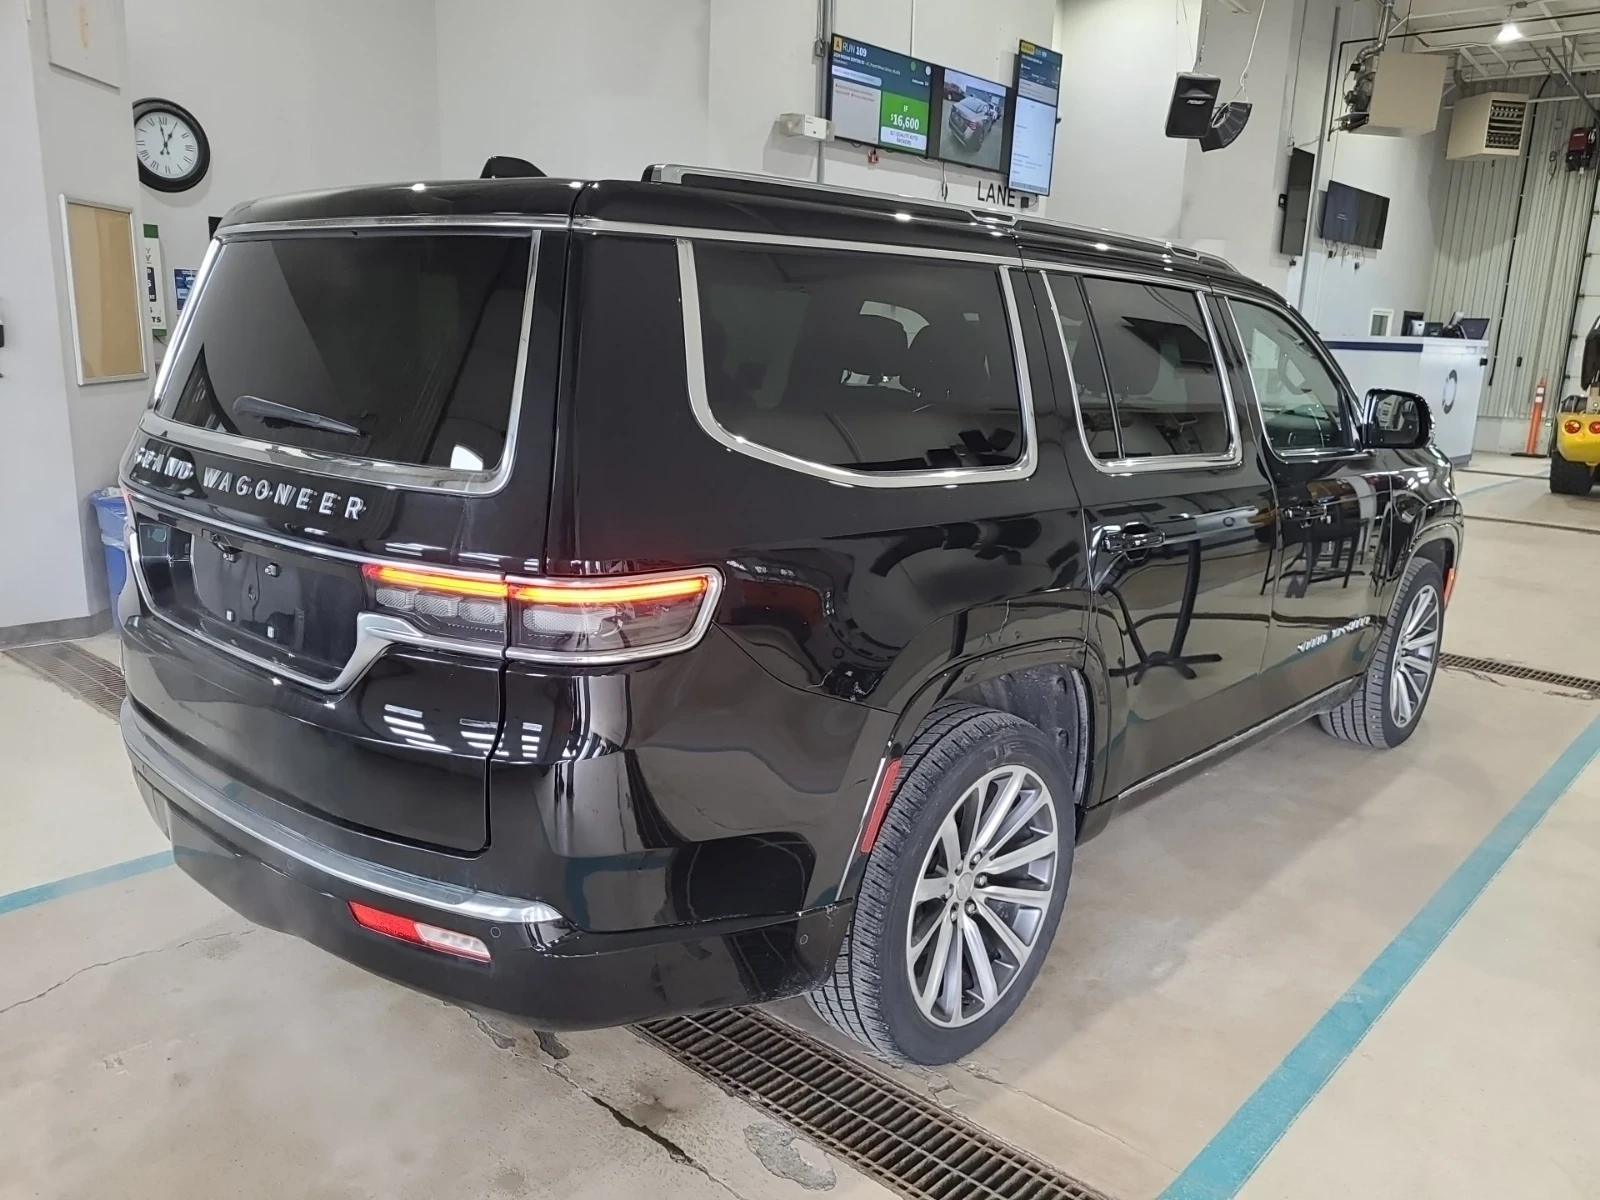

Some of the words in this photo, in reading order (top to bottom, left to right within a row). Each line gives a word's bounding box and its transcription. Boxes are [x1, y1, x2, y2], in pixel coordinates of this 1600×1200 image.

[842, 42, 856, 53] RUN
[855, 46, 867, 57] 109
[890, 112, 920, 131] $16,600
[977, 180, 1016, 208] LANE
[203, 466, 366, 521] WAGONEER
